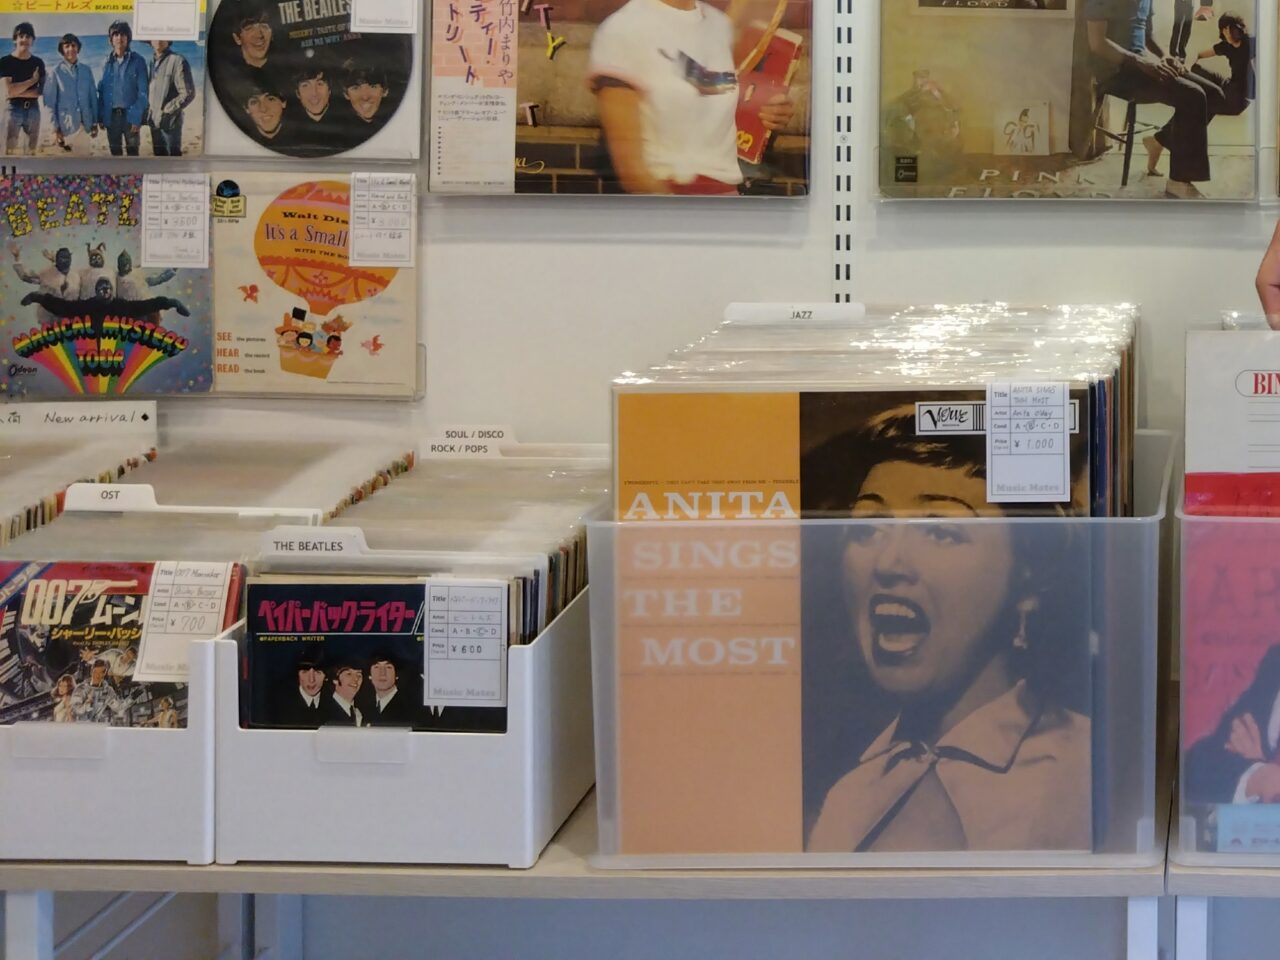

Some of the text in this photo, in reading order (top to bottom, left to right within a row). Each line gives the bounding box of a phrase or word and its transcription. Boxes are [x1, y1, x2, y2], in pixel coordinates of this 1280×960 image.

[26, 0, 92, 10] ビートルズ
[278, 0, 303, 25] THE
[498, 0, 516, 85] 竹内まりや
[979, 168, 1096, 186] PINK
[282, 211, 319, 221] Walt
[265, 223, 286, 241] It's
[289, 229, 298, 241] a
[305, 224, 348, 248] Small
[789, 310, 813, 320] JAZZ
[12, 314, 190, 358] MAGICAL MYSTERY
[217, 331, 233, 342] SEE
[217, 348, 240, 358] HEAR
[75, 348, 126, 374] TOUR
[8, 364, 38, 377] Odeon
[217, 363, 240, 374] READ
[44, 410, 136, 425] New arrival
[445, 430, 504, 439] SOUL DISCO
[431, 444, 488, 454] ROCK POPS
[101, 490, 120, 500] OST
[623, 491, 799, 520] ANITA
[274, 541, 343, 552] THE BEATLES
[632, 540, 799, 571] SINGS
[22, 579, 105, 625] 007
[432, 594, 447, 602] Title
[622, 587, 743, 618] THE
[181, 615, 206, 631] 700
[461, 644, 482, 654] 600
[641, 637, 796, 667] MOST
